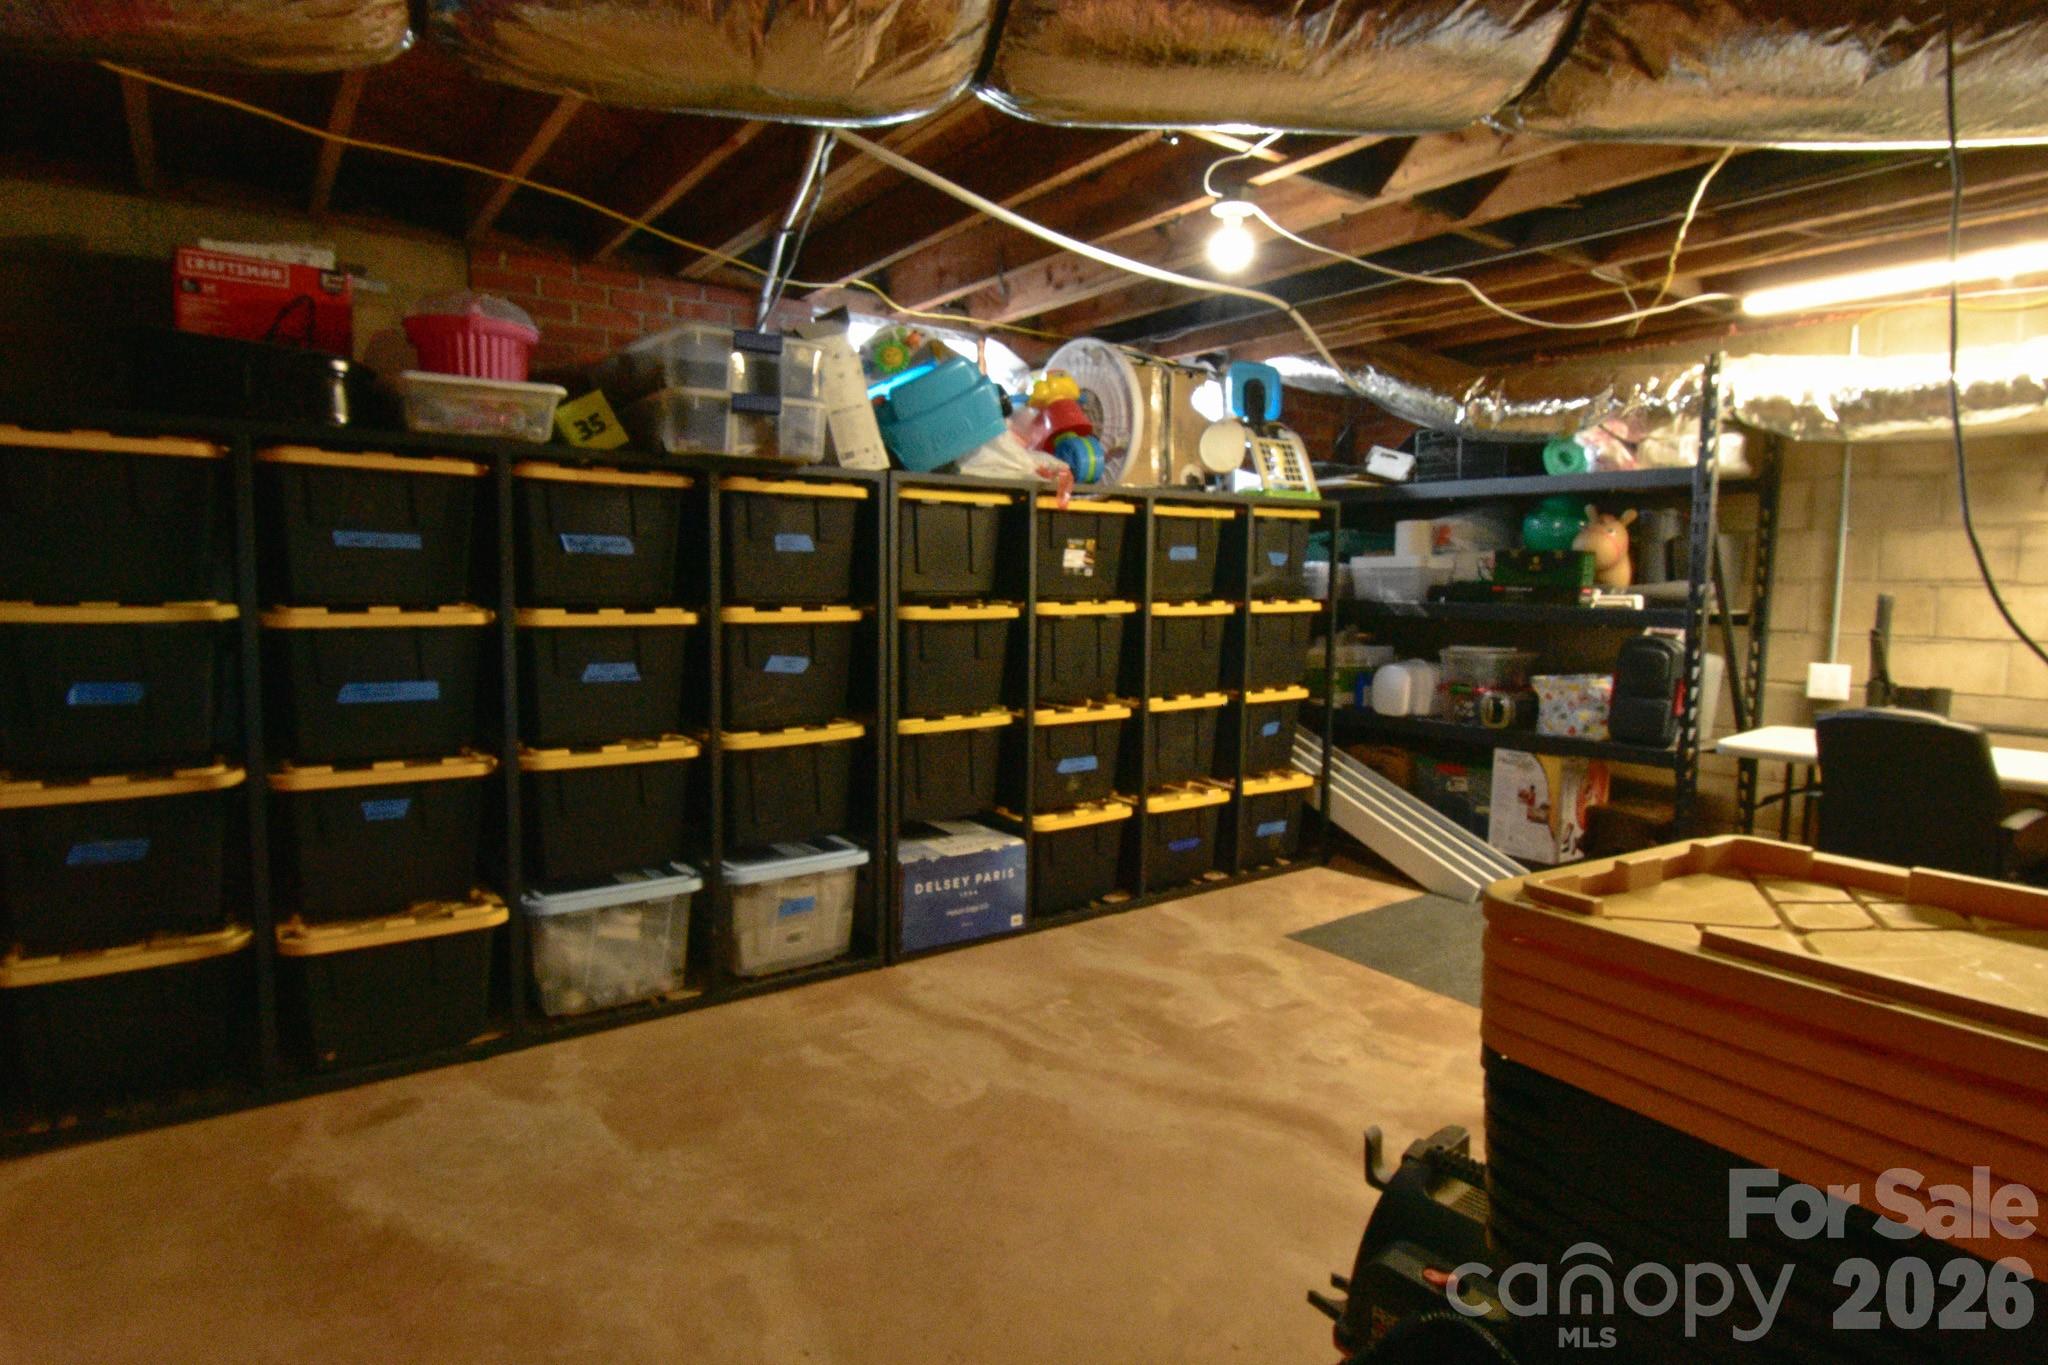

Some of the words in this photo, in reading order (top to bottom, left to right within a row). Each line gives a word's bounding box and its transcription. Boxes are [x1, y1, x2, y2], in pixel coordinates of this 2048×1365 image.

[573, 412, 606, 440] 35
[914, 875, 970, 895] DELSEY
[975, 867, 1015, 885] PARIS
